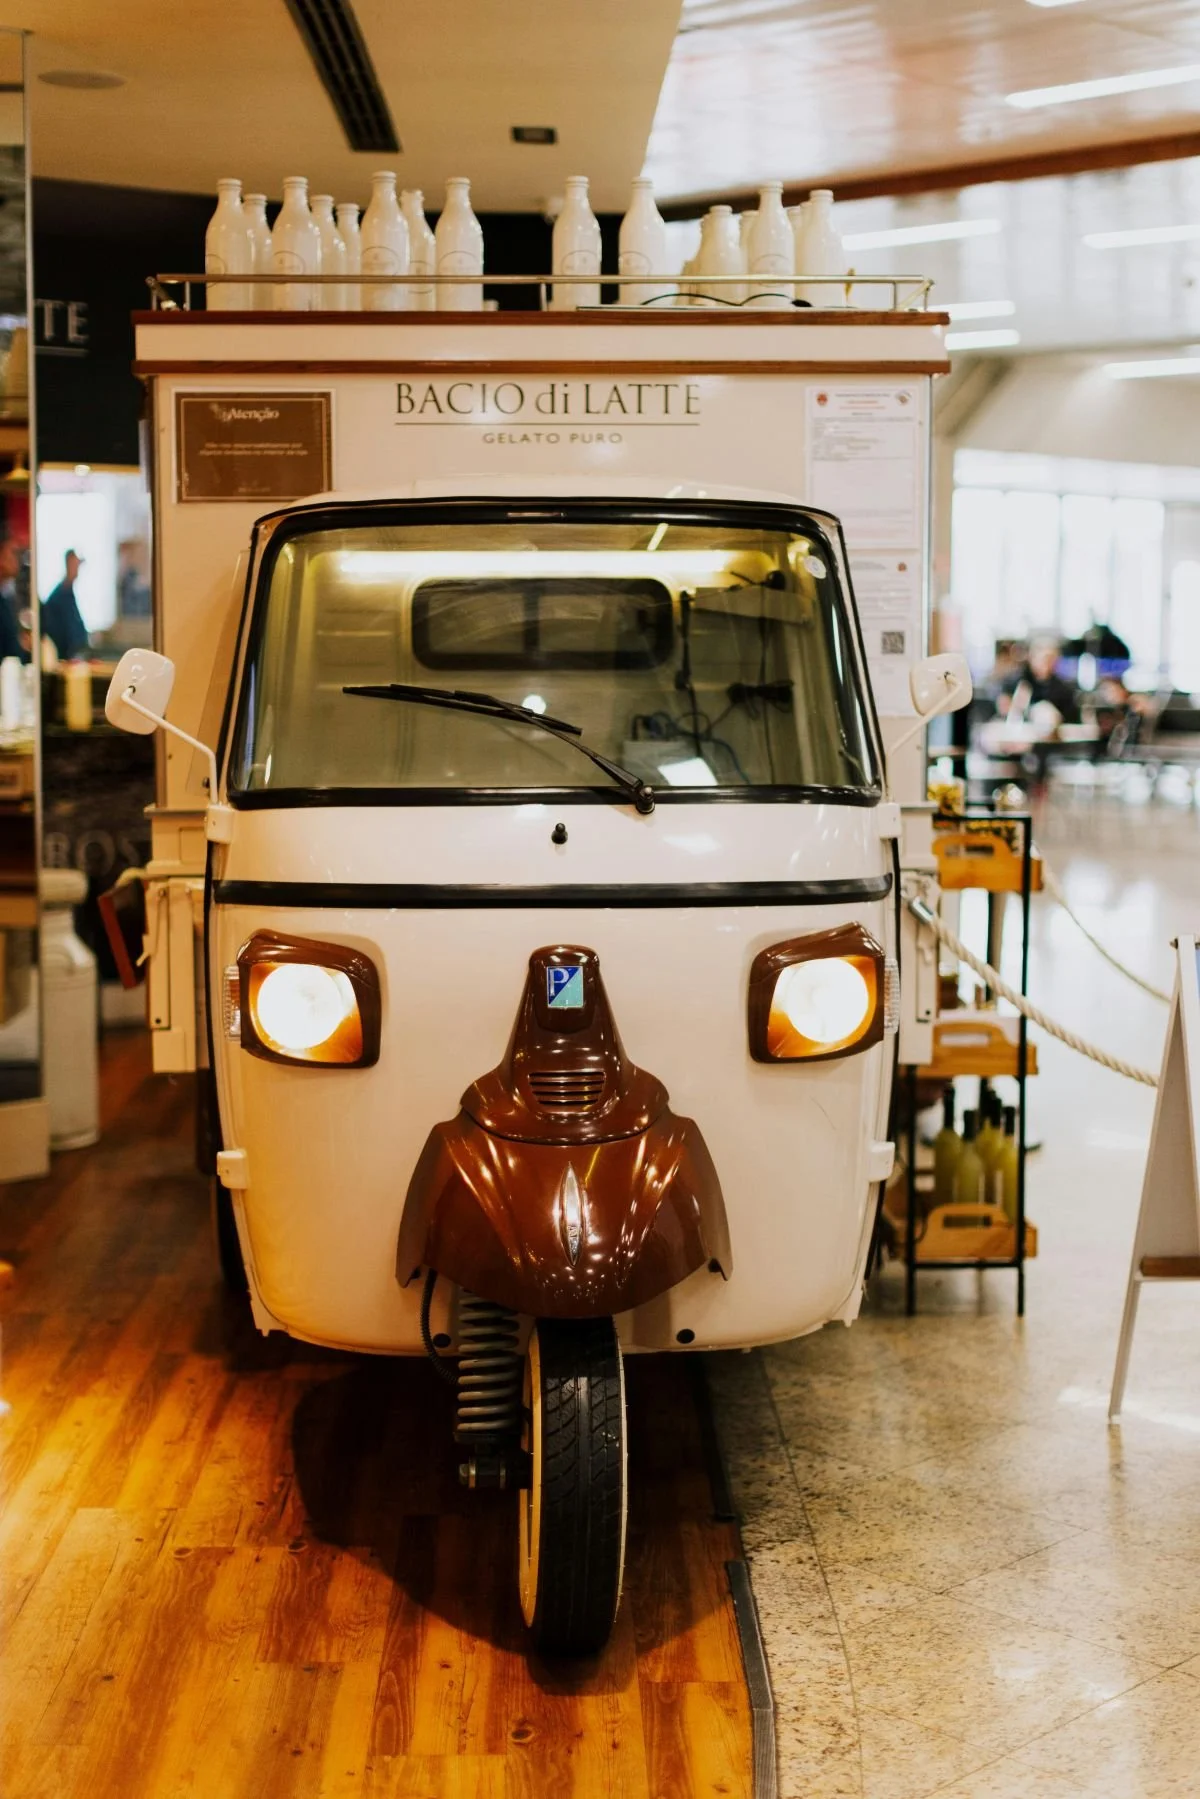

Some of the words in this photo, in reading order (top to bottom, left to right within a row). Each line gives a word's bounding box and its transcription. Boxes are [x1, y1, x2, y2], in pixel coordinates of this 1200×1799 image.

[395, 383, 525, 415] BACIO
[535, 384, 569, 415] di
[584, 384, 702, 415] LATTE
[229, 406, 280, 421] Atenção
[482, 432, 561, 444] GELATO
[569, 432, 623, 444] PURO
[549, 967, 570, 997] P
